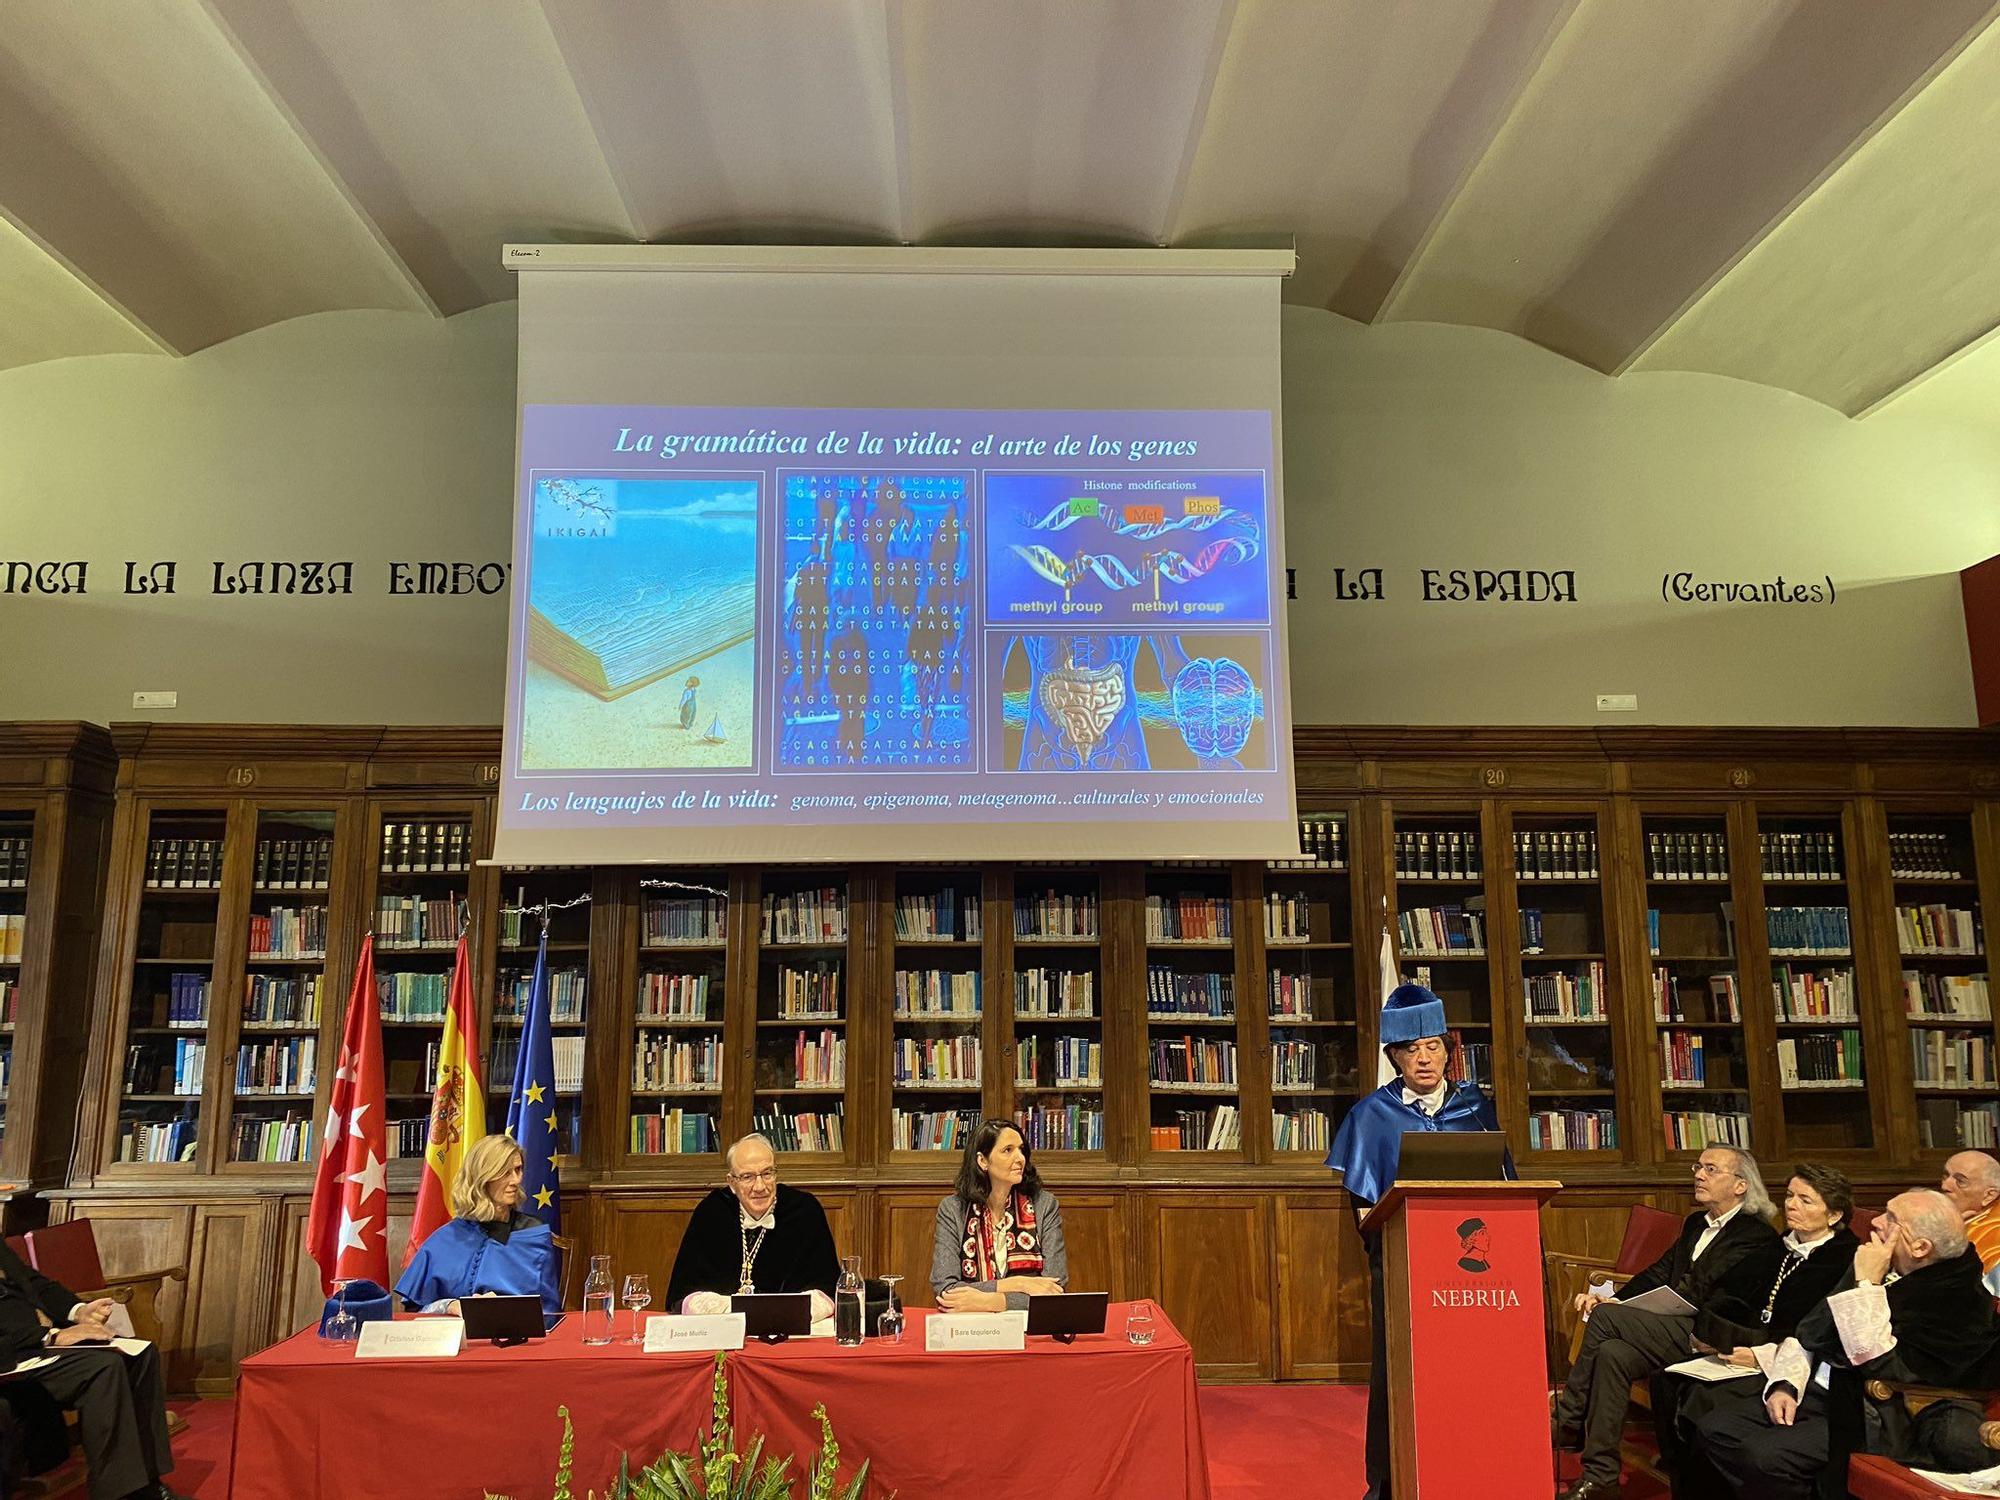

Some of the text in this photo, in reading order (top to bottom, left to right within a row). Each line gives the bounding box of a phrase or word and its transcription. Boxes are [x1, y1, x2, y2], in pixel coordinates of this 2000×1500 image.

[613, 428, 1198, 462] La gramática de la vida: el arte de los genes
[1083, 480, 1197, 490] Histone modifications
[1073, 502, 1091, 513] Ac
[1188, 501, 1218, 513] Phos
[1133, 509, 1159, 521] Met
[548, 528, 606, 537] IKIGAI
[0, 561, 512, 595] NCA LA LANZA EMBO
[1333, 568, 1385, 600] LA
[1420, 569, 1578, 602] ESPADA
[1662, 572, 1836, 605] (Cervantes)
[1010, 601, 1103, 614] methyl group
[1132, 601, 1224, 614] methyl group
[237, 768, 253, 783] 15
[484, 765, 499, 780] 16
[1486, 769, 1505, 785] 20
[1734, 769, 1750, 785] 21
[520, 792, 559, 811] Los
[565, 791, 665, 814] lenguajes
[672, 790, 696, 809] de
[702, 790, 722, 809] la
[727, 790, 777, 808] vida:
[790, 795, 857, 812] genoma,
[863, 794, 952, 811] epigenoma,
[1153, 793, 1164, 808] y
[1168, 789, 1264, 805] emocionales
[1432, 1289, 1520, 1310] NEBRIJA
